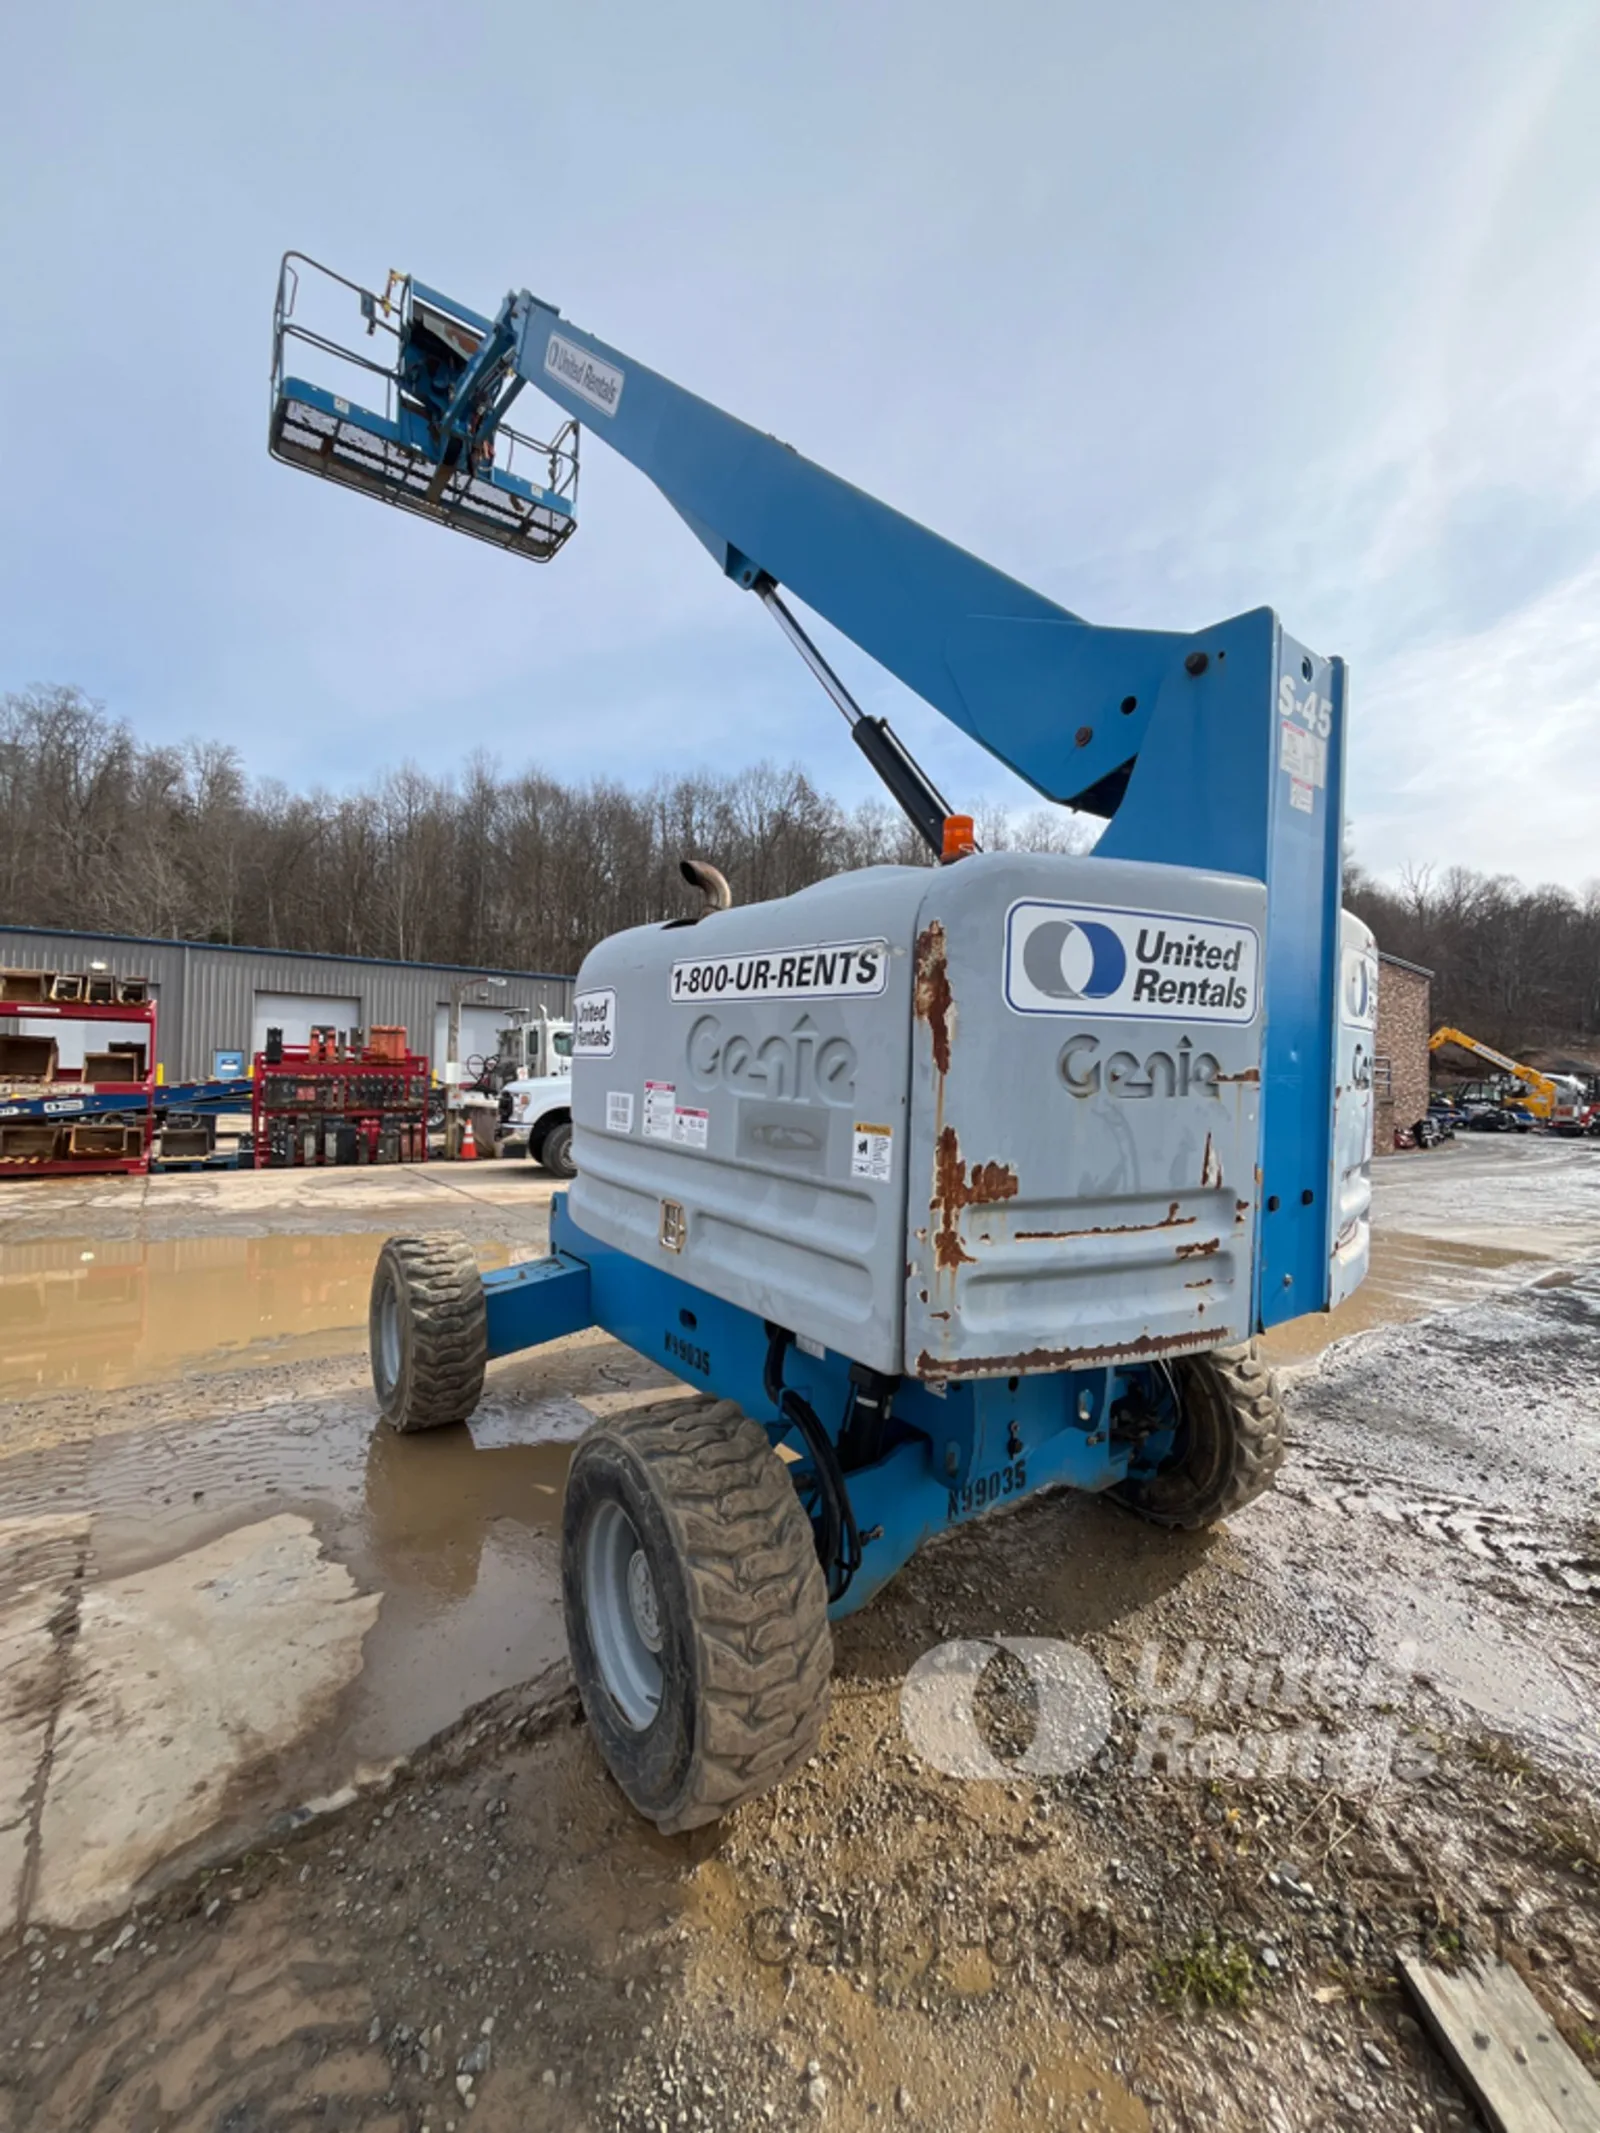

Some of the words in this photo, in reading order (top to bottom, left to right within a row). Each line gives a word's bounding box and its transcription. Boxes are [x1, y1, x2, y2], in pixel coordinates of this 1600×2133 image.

[556, 348, 587, 384] United
[582, 364, 617, 405] Rentals
[1278, 675, 1333, 739] S-45
[673, 950, 879, 995] 1-800-UR-RENTS
[1135, 929, 1243, 972] United
[1132, 968, 1248, 1010] Rentals
[685, 1012, 858, 1109] Genie
[1057, 1033, 1222, 1099] Genie
